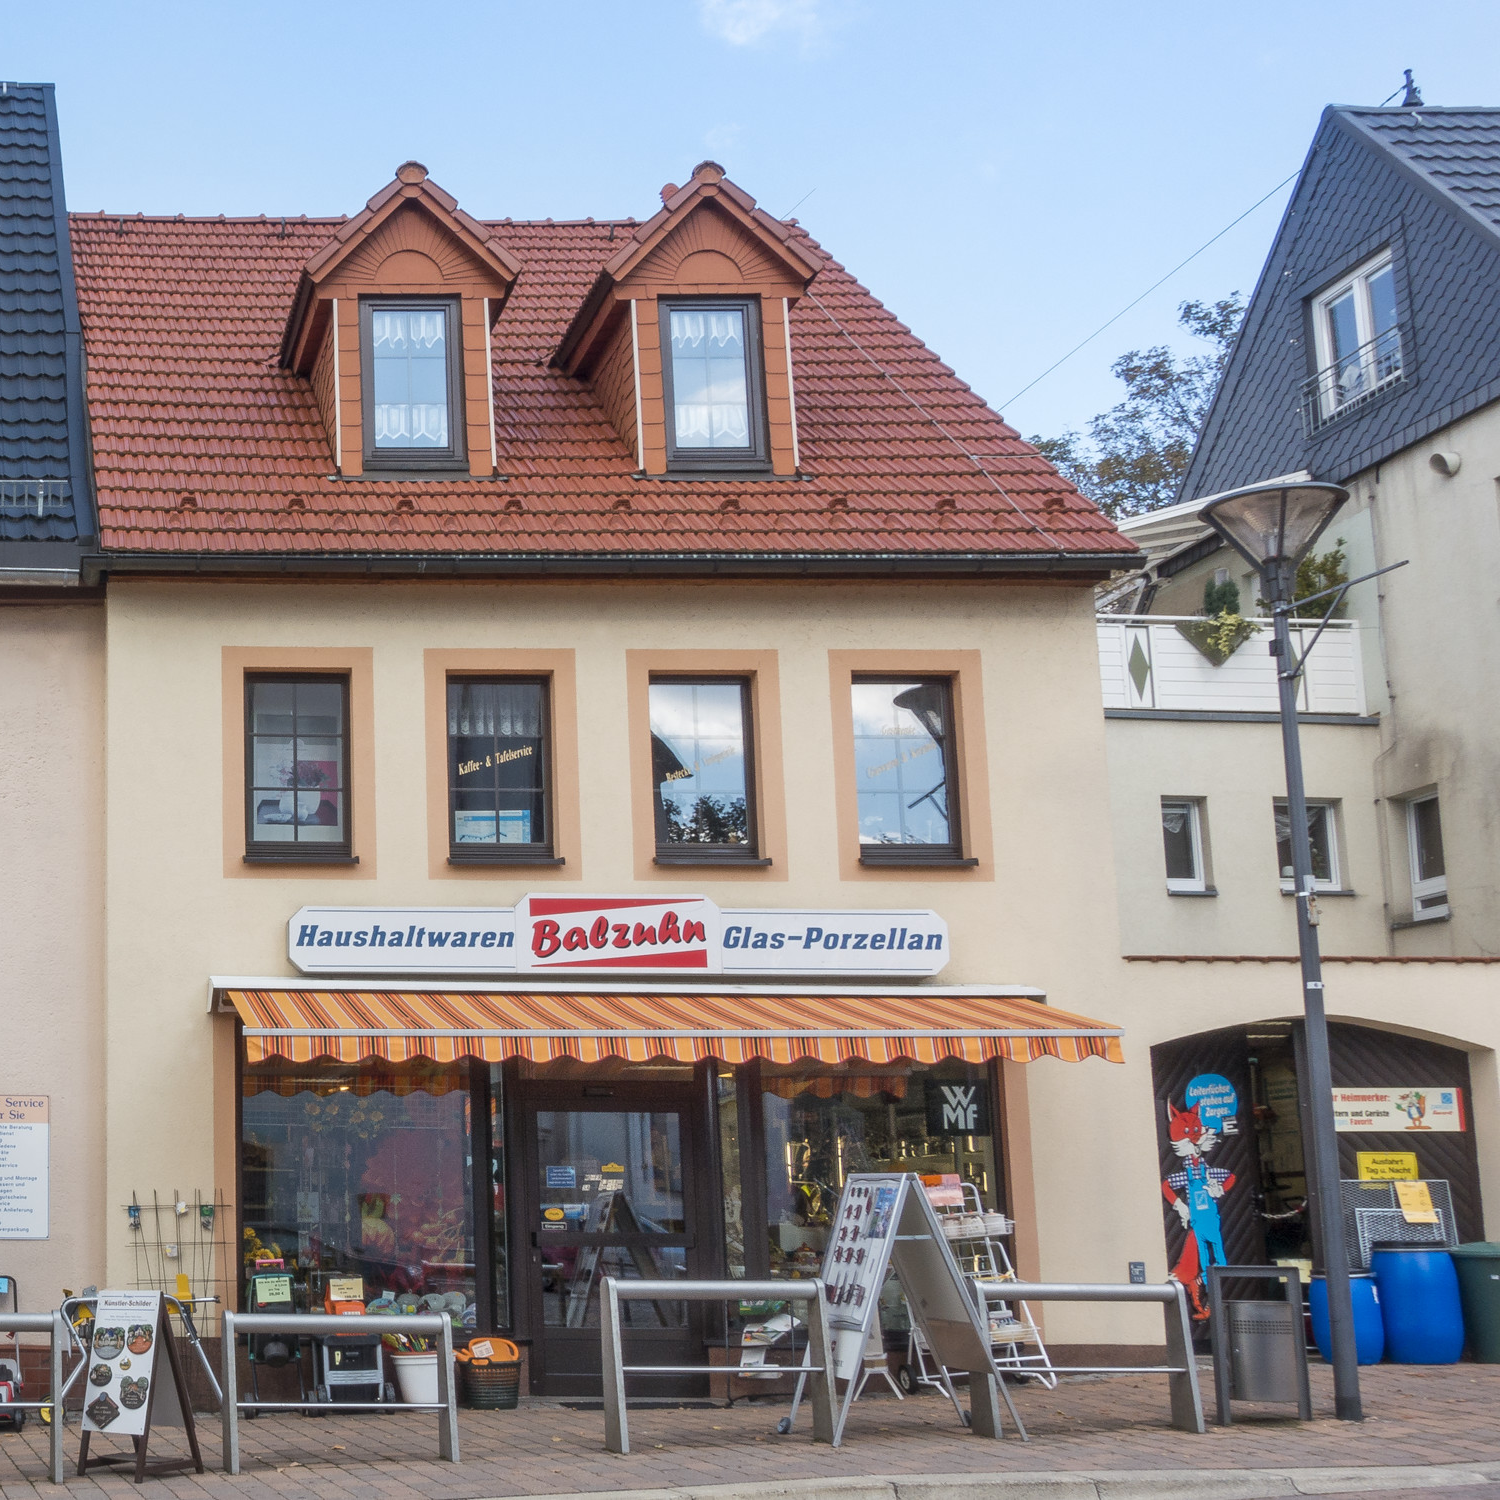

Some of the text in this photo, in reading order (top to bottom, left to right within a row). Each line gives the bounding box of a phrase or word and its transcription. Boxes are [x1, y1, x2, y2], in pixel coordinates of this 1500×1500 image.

[458, 745, 533, 776] Kaffee- & Tafelservice
[296, 924, 514, 950] Haushaltwaren
[529, 916, 707, 958] Balzuhn
[722, 924, 944, 952] Glas-Porzellan
[1188, 1083, 1231, 1097] Leiterfüchse
[5, 1097, 44, 1107] Service
[1200, 1092, 1236, 1107] stehen auf
[1340, 1093, 1391, 1102] Heimwerker:
[9, 1109, 25, 1119] Sie
[940, 1085, 979, 1130] WMF
[1205, 1106, 1231, 1118] Zarges.
[1365, 1109, 1390, 1117] Gerüste
[1365, 1166, 1379, 1174] Tag
